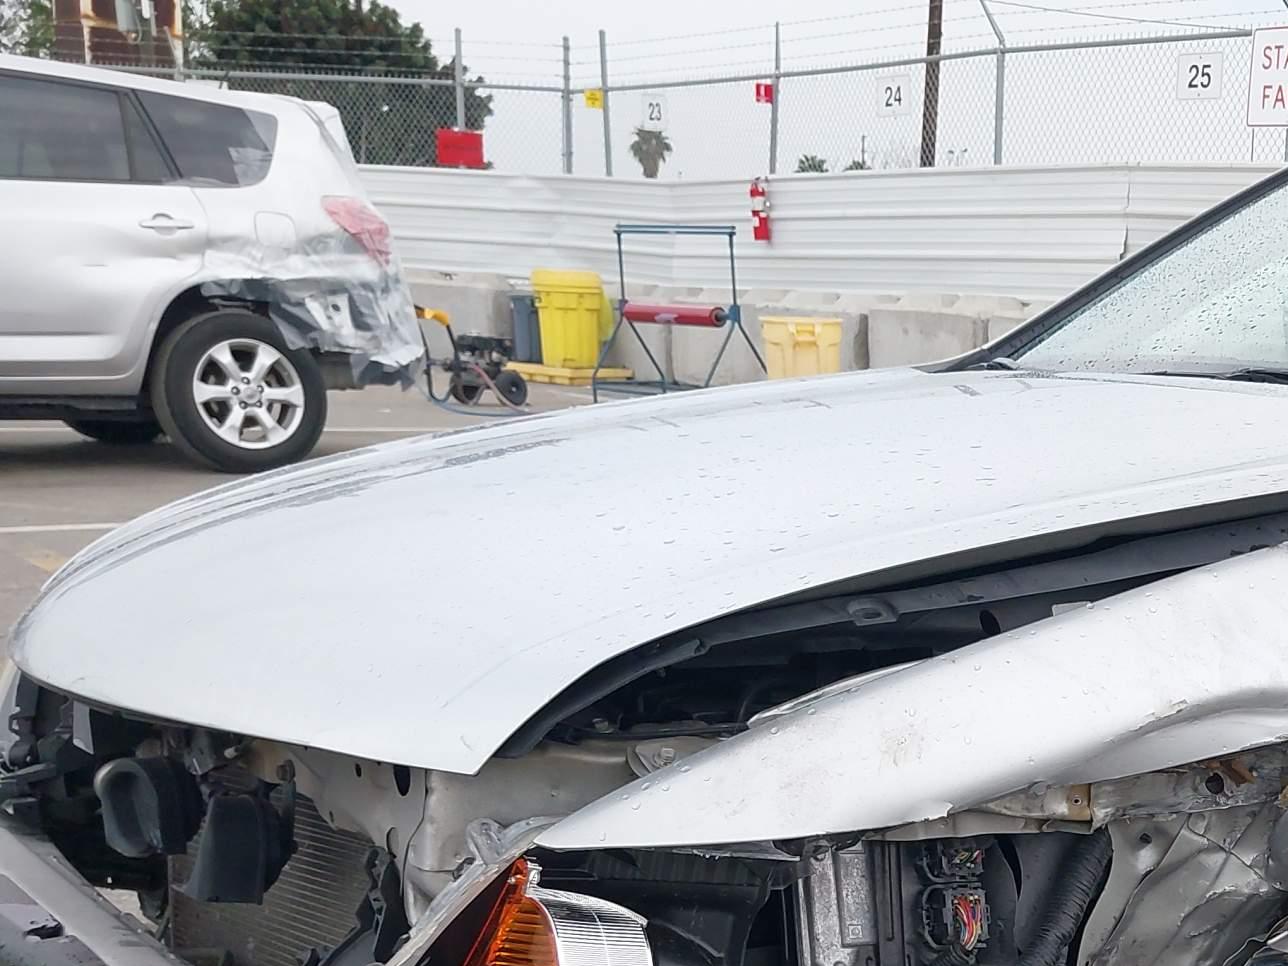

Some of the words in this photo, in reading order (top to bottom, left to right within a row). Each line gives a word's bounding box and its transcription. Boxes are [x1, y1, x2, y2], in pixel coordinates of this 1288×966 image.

[1188, 64, 1212, 88] 25
[884, 85, 902, 107] 24
[648, 102, 662, 121] 23
